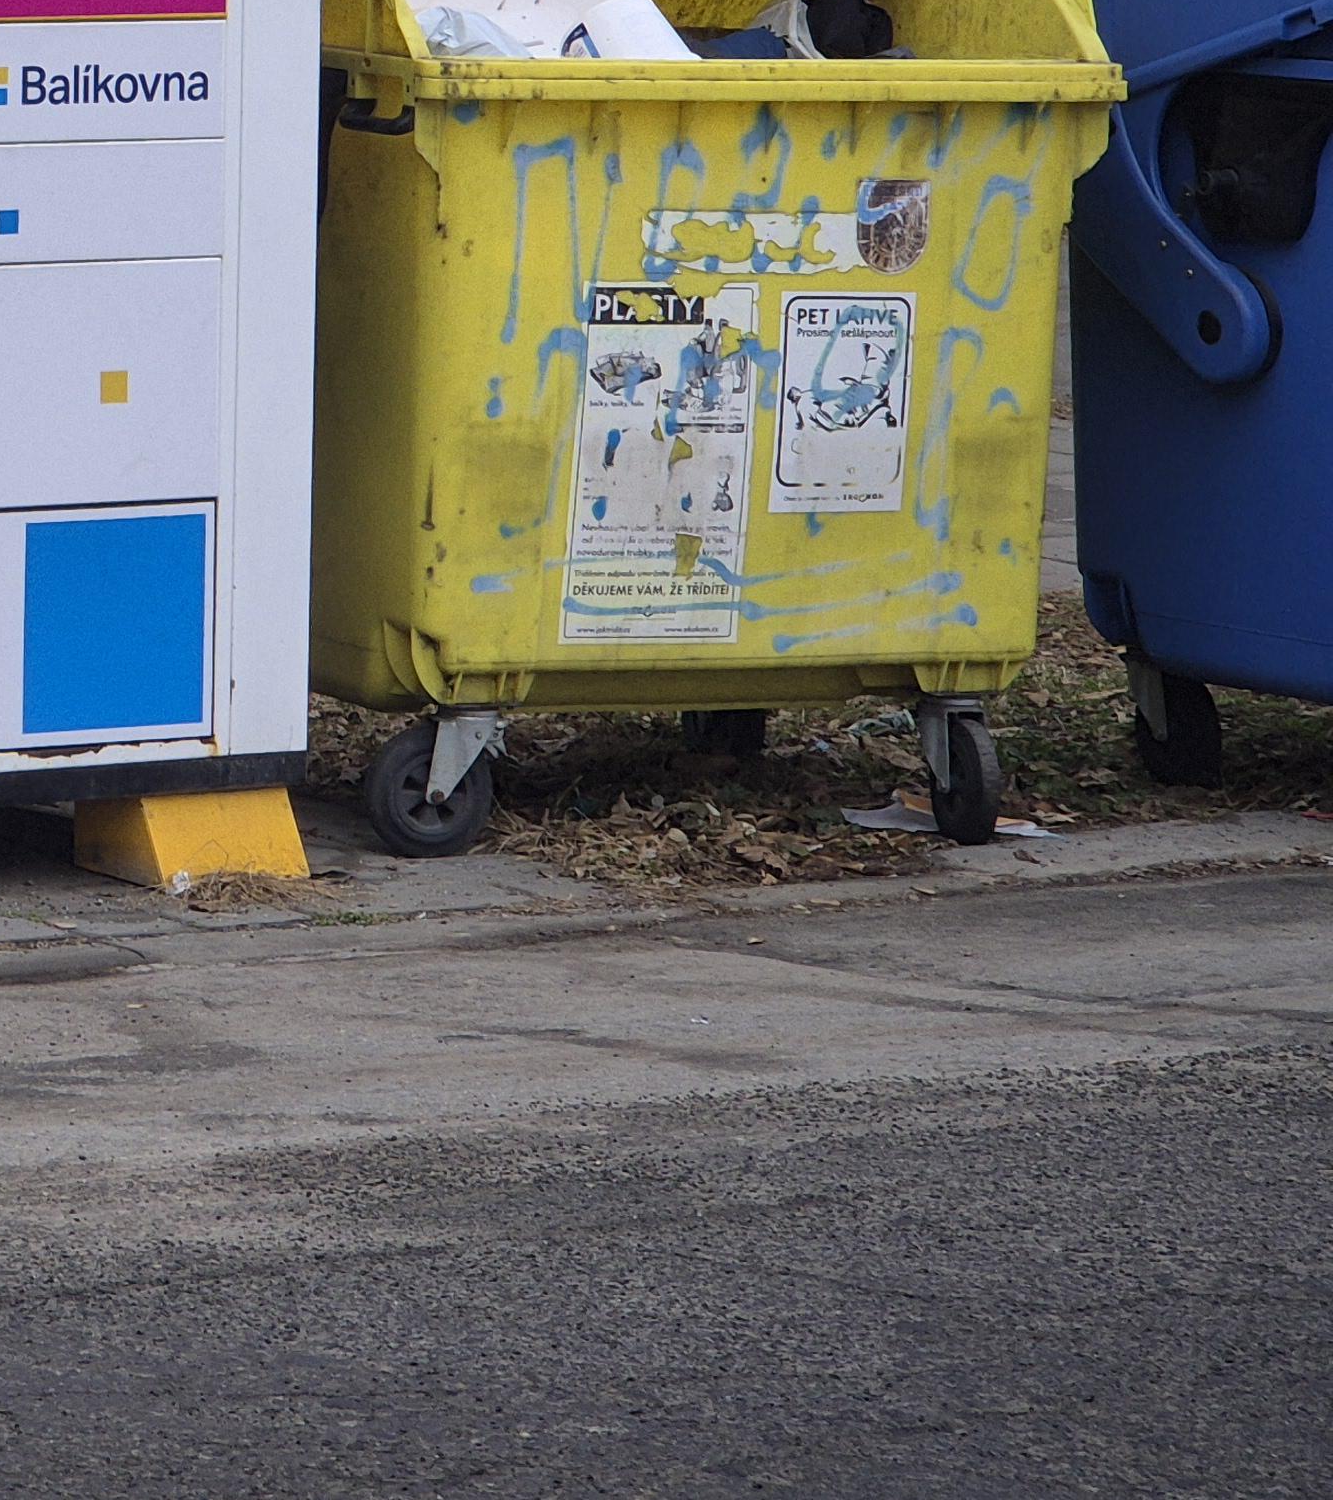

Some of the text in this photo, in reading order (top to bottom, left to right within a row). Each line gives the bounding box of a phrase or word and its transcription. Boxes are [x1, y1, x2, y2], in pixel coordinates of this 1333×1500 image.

[21, 64, 209, 106] Balíkovna
[797, 307, 830, 325] PET
[573, 581, 730, 597] DĚKUJEME VÁM, ŽE TŘÍDÍTE!
